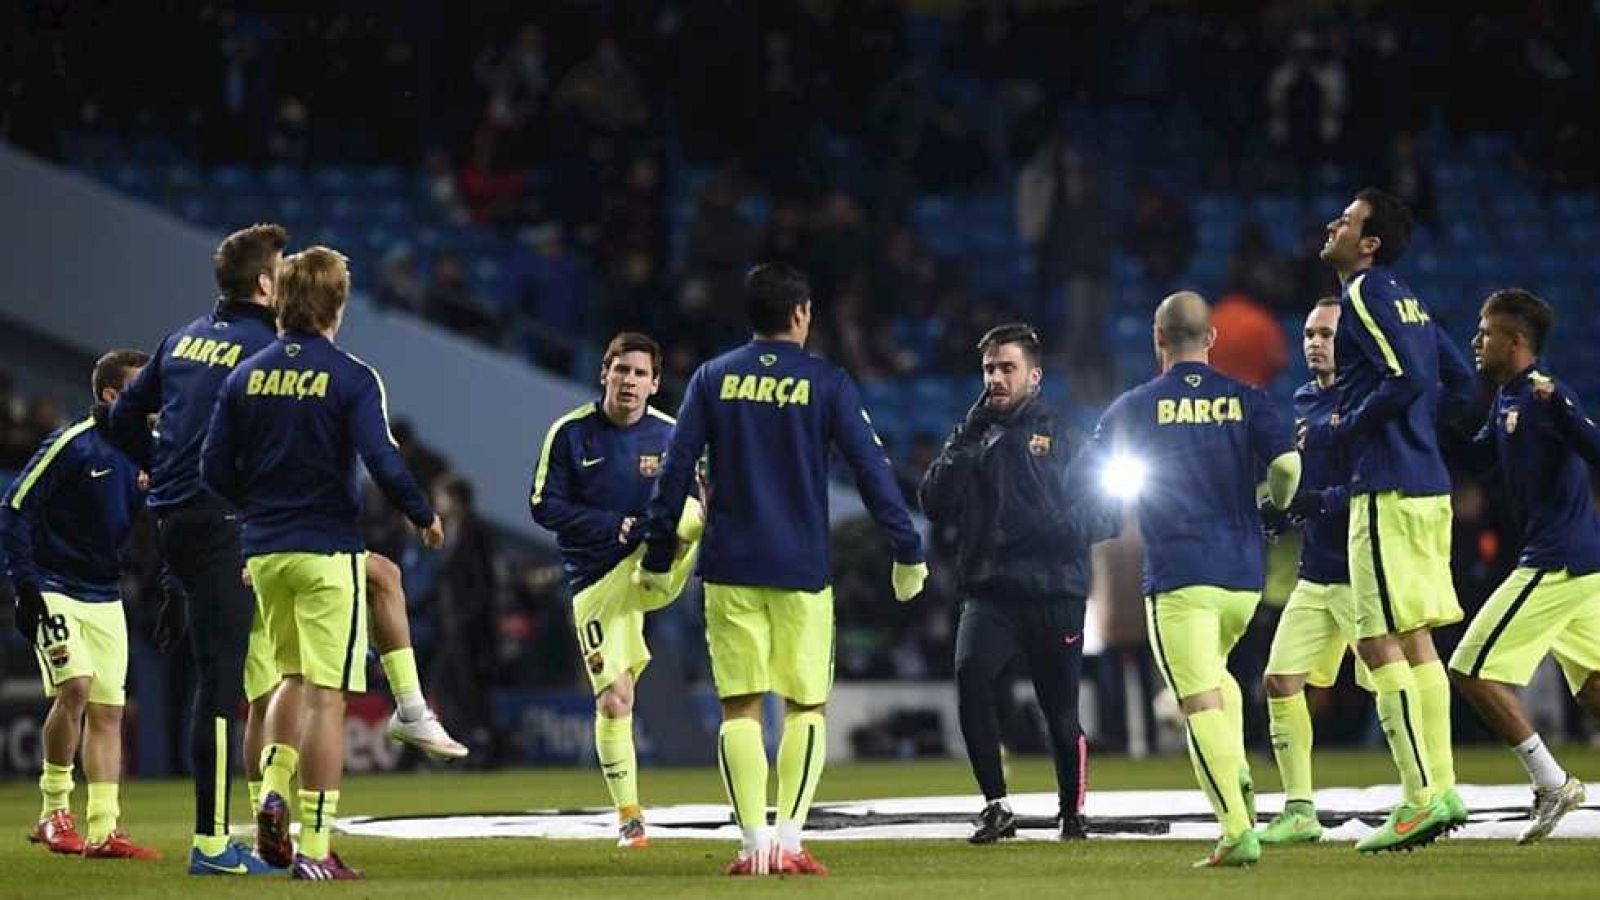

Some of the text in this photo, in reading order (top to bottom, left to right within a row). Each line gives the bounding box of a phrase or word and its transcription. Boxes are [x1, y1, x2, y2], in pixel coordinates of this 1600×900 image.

[172, 335, 242, 368] BARÇA
[247, 369, 329, 400] BARÇA
[720, 374, 810, 408] BARÇA
[1157, 397, 1243, 426] BARÇA
[44, 614, 70, 647] 18
[579, 620, 604, 655] 10
